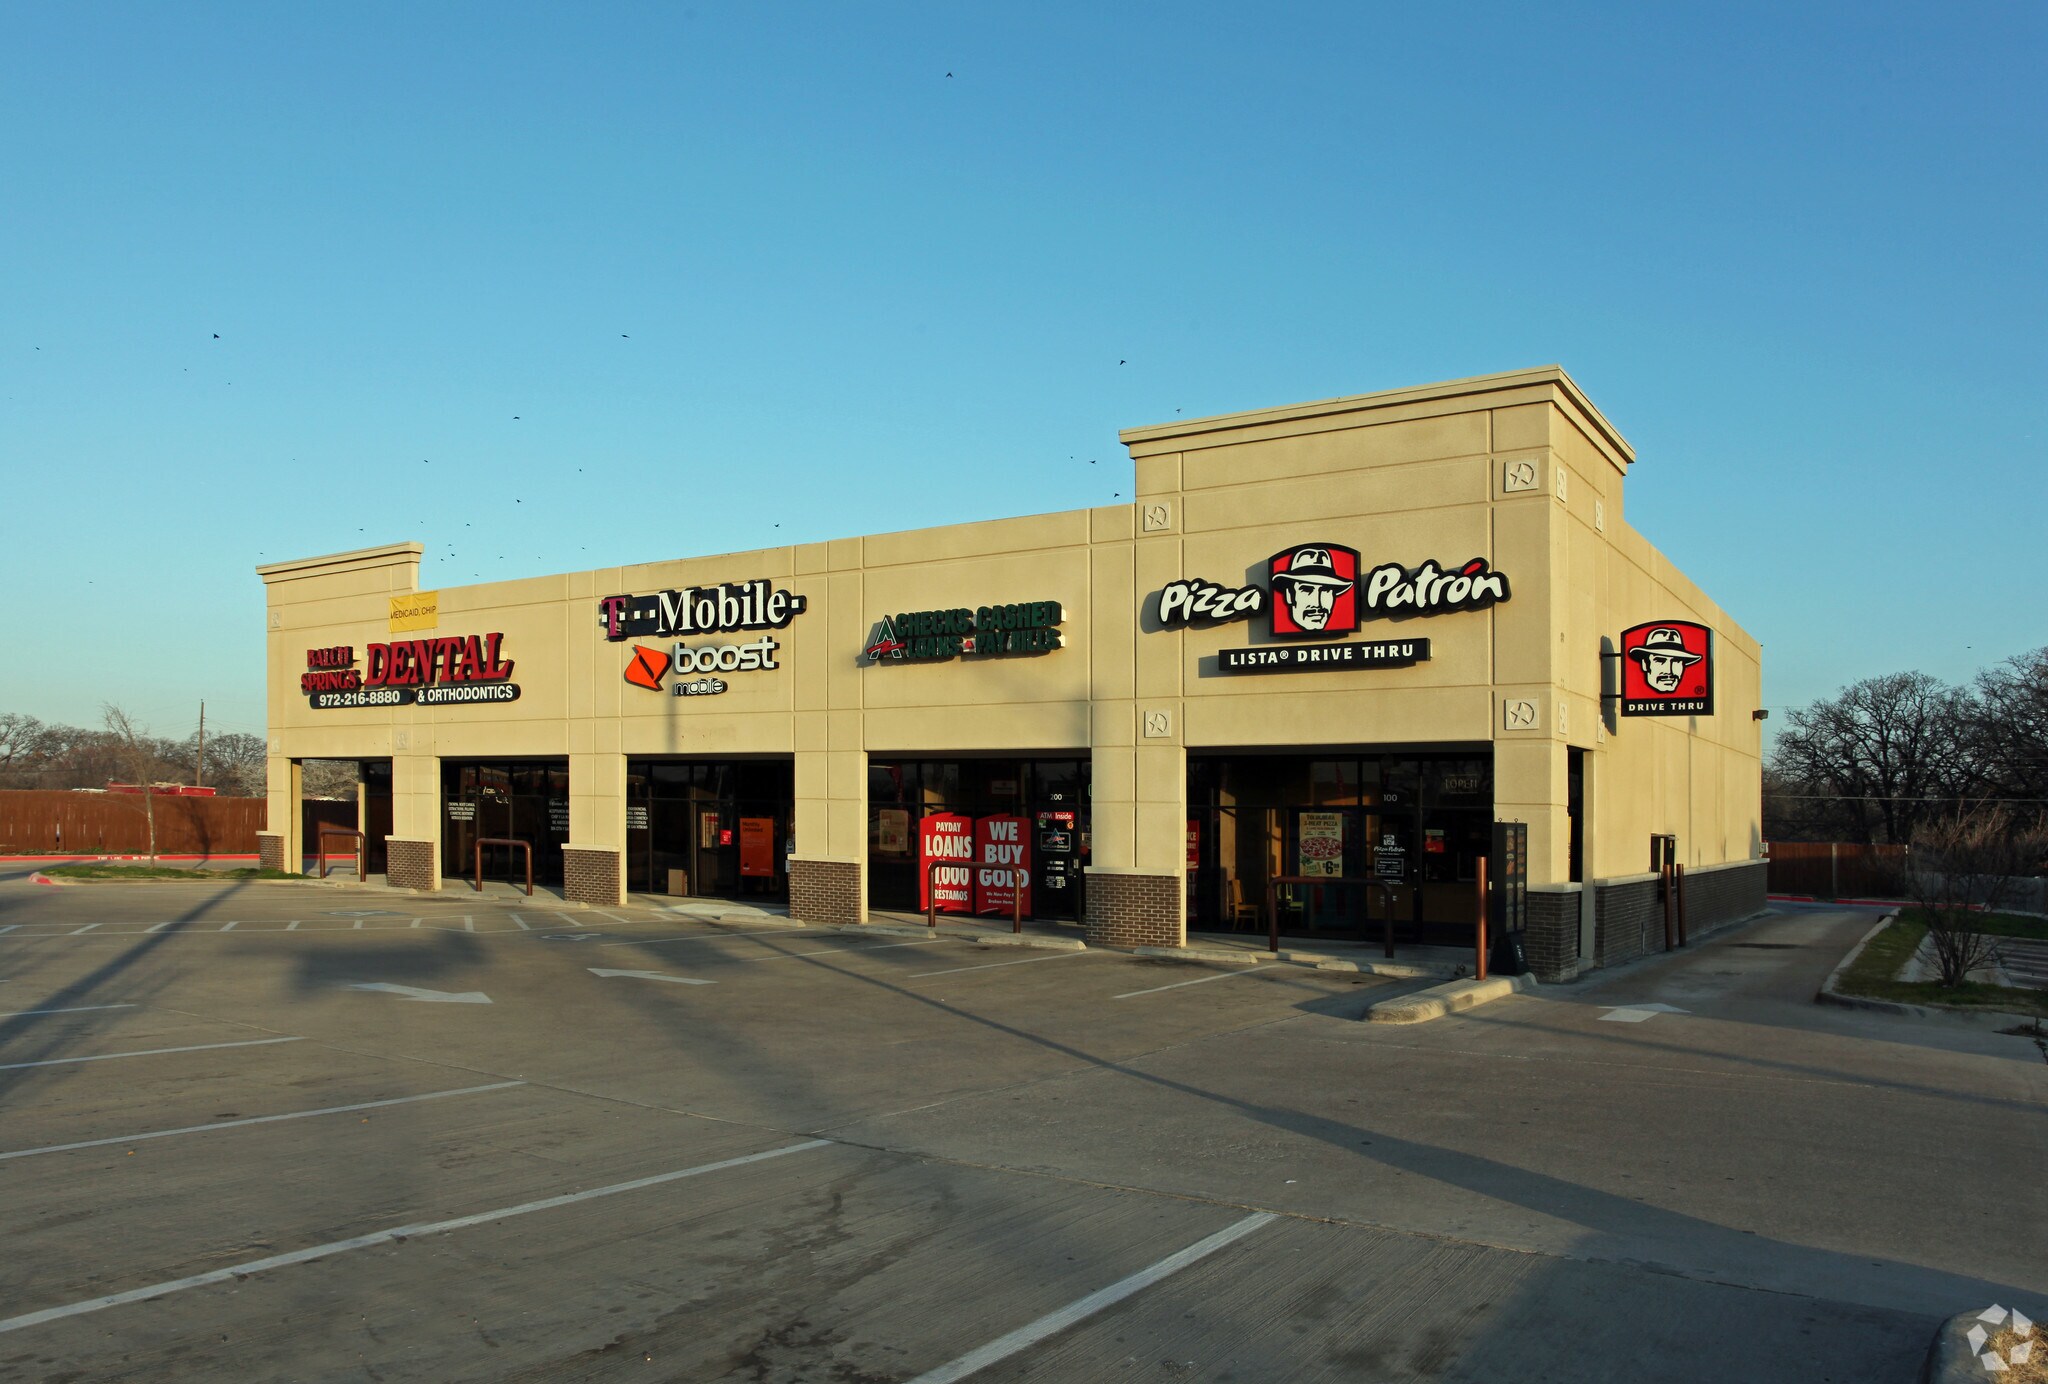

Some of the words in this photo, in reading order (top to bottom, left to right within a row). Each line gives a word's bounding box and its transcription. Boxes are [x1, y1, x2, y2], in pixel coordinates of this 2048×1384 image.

[1160, 583, 1262, 622] Pizza
[1369, 560, 1504, 608] Patrón
[421, 605, 437, 615] CHIP
[895, 607, 974, 638] CHECKS
[975, 601, 1060, 631] CASHED
[906, 636, 963, 658] LOANS
[975, 632, 1008, 655] PAY
[1008, 628, 1061, 651] BILLS
[1297, 647, 1353, 662] DRIVE
[1362, 643, 1414, 659] THRU
[306, 645, 352, 668] BALCH
[365, 632, 514, 686] DENTAL
[674, 635, 776, 673] boost
[301, 669, 359, 691] SPRINGS
[675, 677, 724, 696] mobile
[319, 690, 400, 706] 972-216-8880
[417, 692, 426, 703] &
[427, 685, 514, 703] ORTHODONTICS
[1628, 703, 1666, 711] DRIVE
[1671, 702, 1704, 710] THRU
[1383, 794, 1398, 802] 100
[1054, 811, 1072, 820] Inside
[936, 821, 961, 833] PAYDAY
[988, 821, 1018, 842] WE
[925, 834, 973, 859] LOANS
[984, 844, 1024, 865] BUY
[979, 868, 1030, 888] GOLD
[934, 887, 968, 902] RÉSTAMOS
